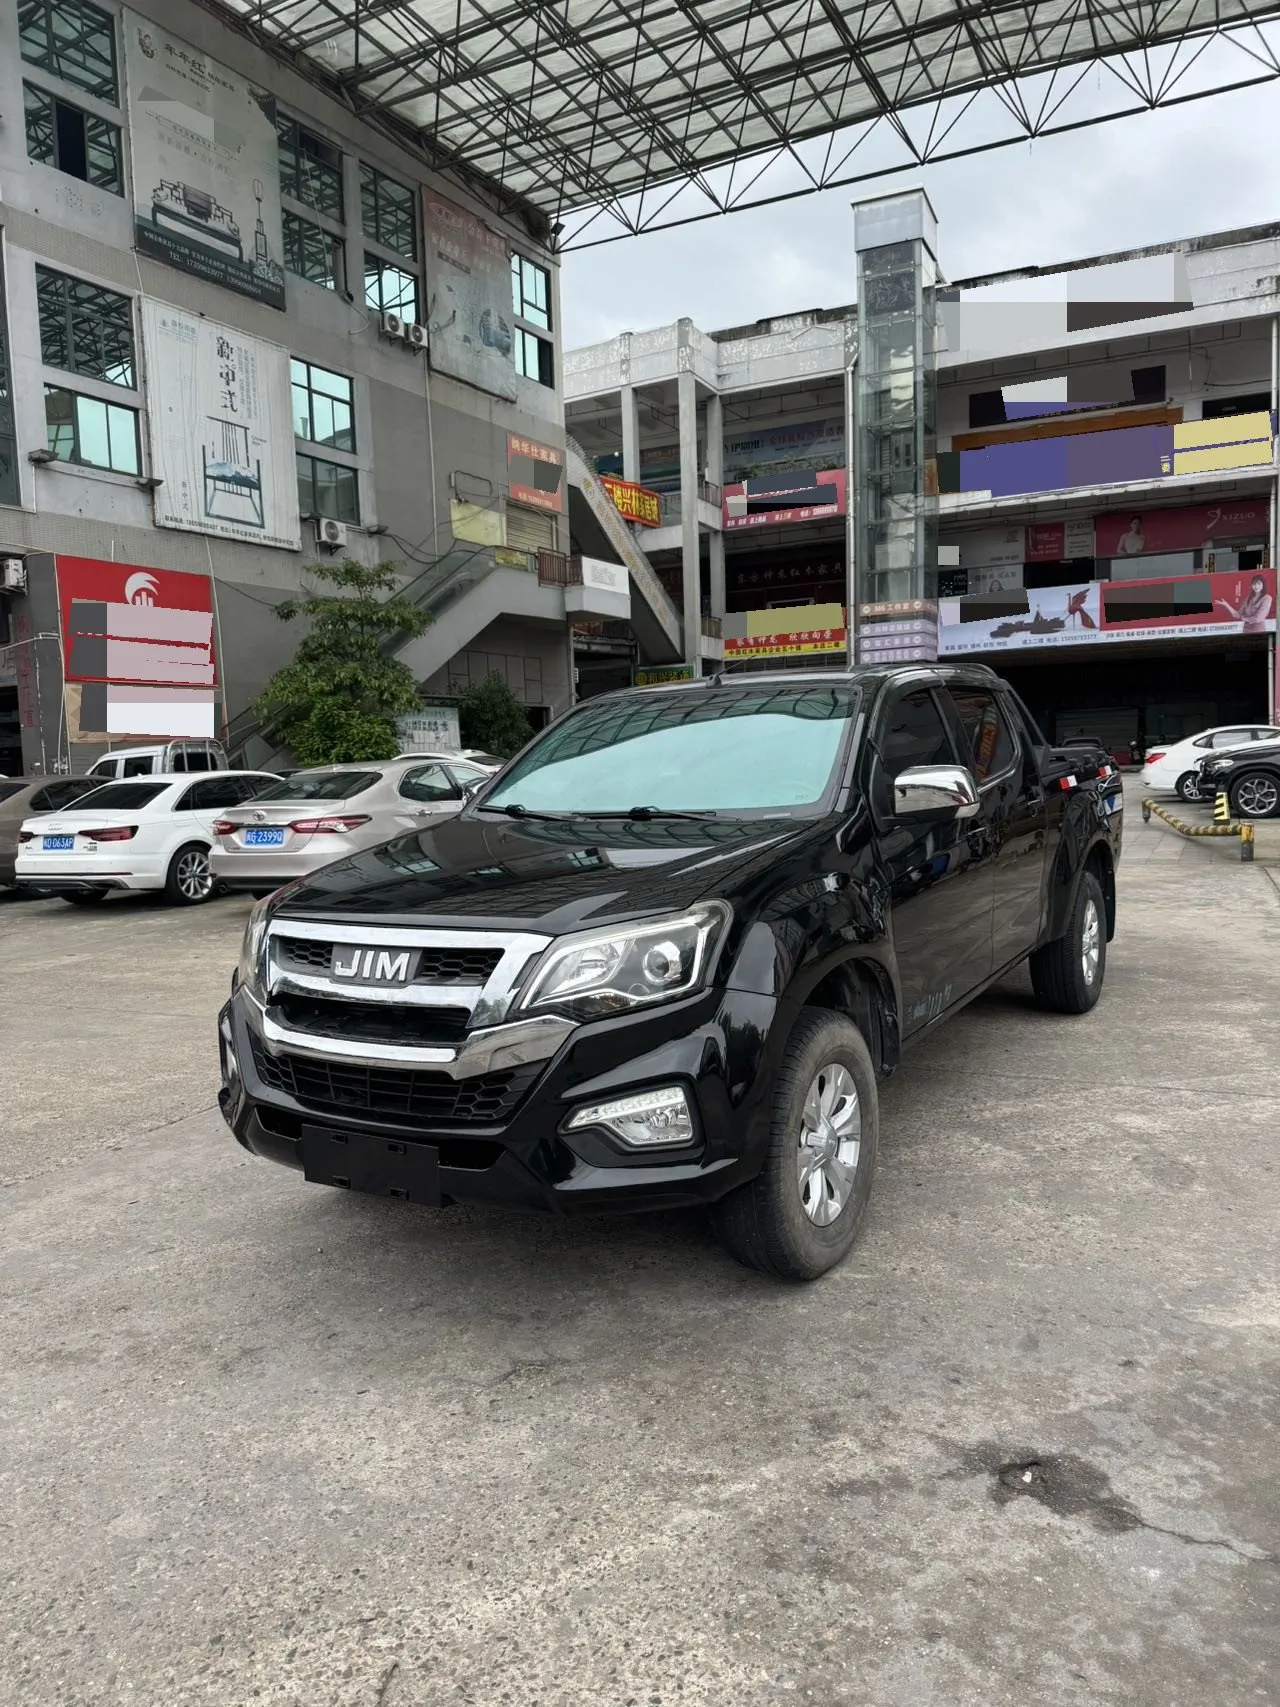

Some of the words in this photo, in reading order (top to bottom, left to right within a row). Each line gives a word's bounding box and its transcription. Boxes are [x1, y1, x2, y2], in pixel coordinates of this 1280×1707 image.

[215, 335, 238, 413] 新中式
[335, 949, 411, 982] JIM
